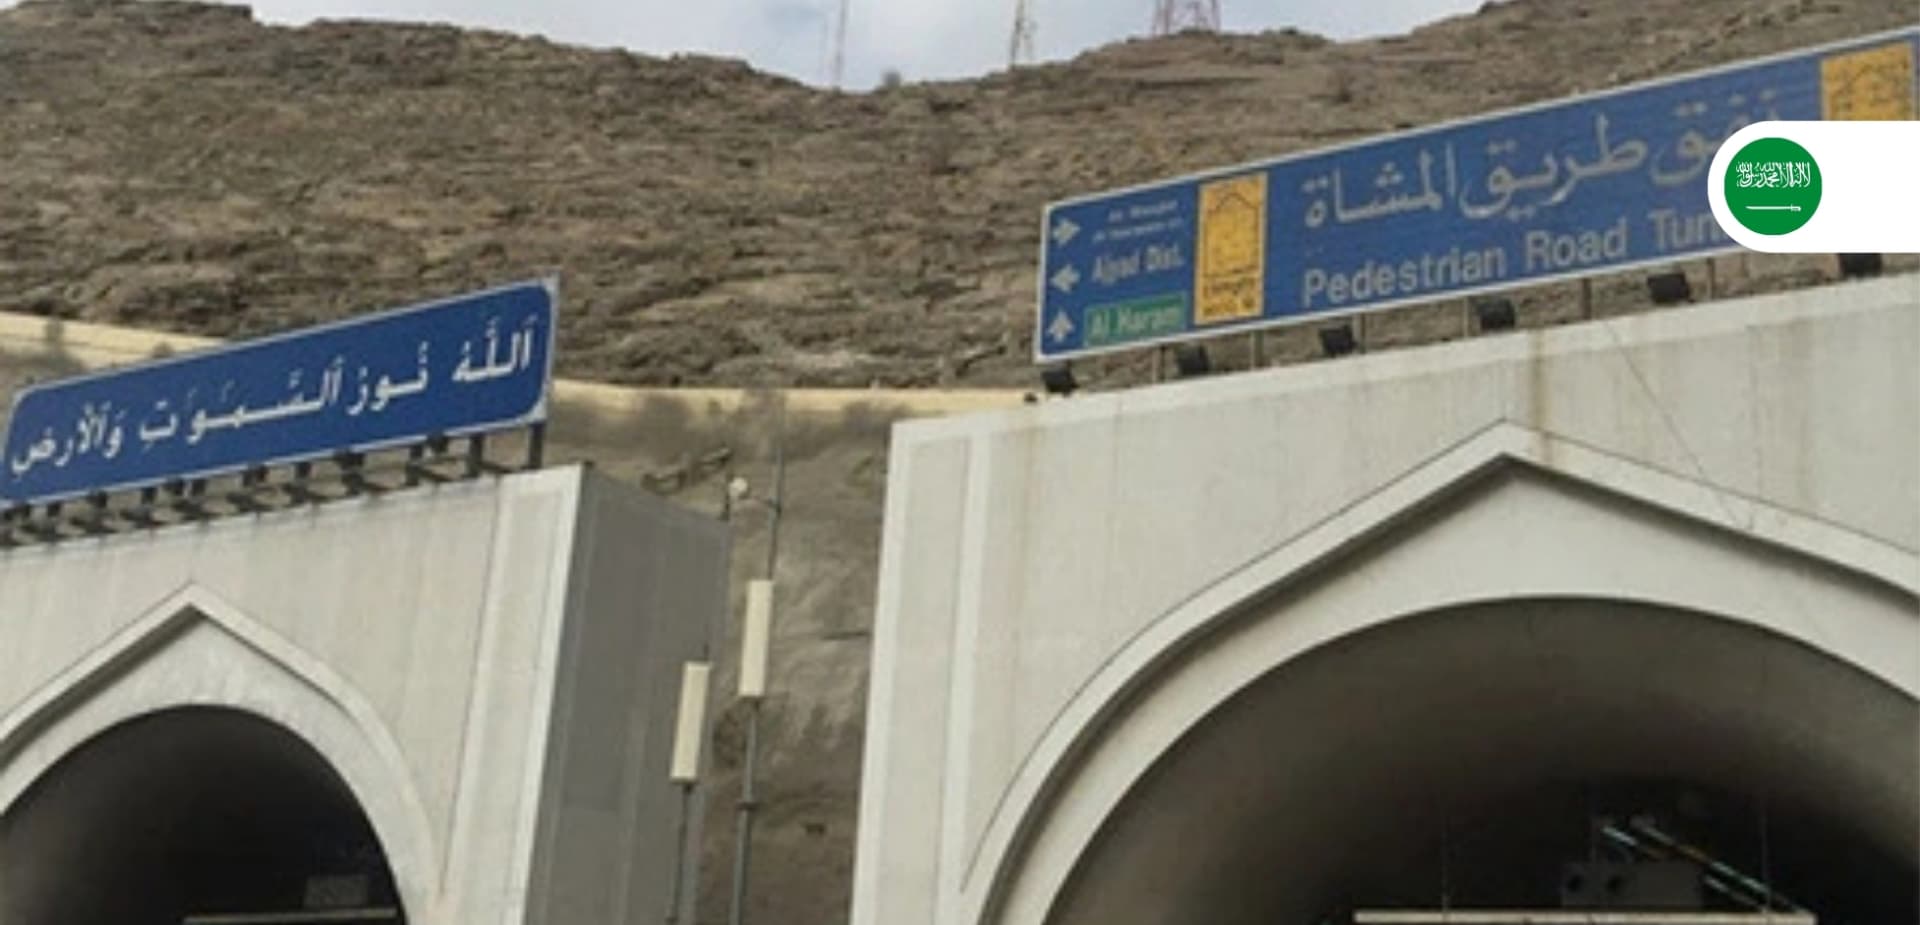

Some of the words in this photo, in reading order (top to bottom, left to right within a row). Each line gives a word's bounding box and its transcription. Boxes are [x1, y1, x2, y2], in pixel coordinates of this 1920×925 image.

[1303, 142, 1457, 228] المشاة
[1460, 113, 1648, 221] طريق
[1304, 246, 1506, 307] Pedestrian
[1525, 218, 1628, 271] Road
[1648, 209, 1732, 250] Tun
